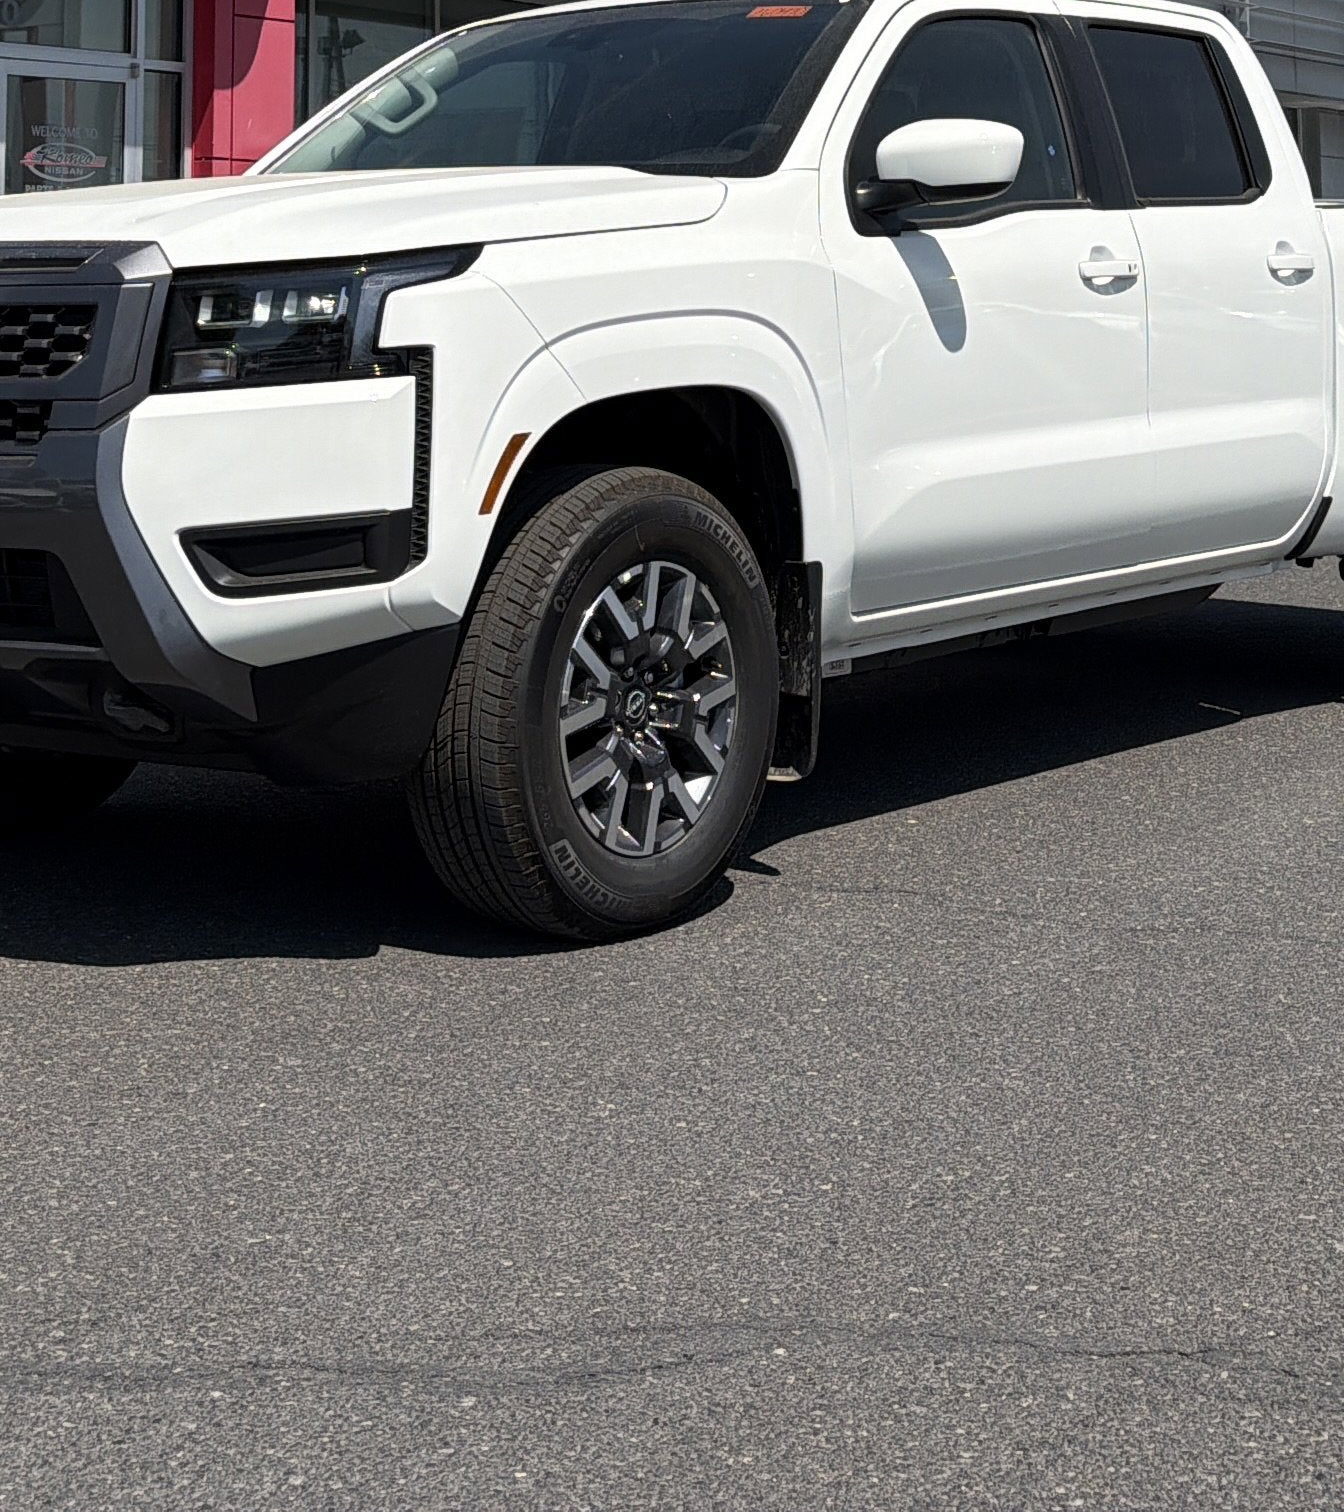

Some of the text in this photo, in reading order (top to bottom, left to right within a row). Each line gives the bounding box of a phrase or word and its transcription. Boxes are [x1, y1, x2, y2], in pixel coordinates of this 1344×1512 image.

[31, 124, 81, 138] WELCOME
[35, 144, 94, 165] Romeo
[44, 165, 84, 176] NISSAN
[695, 510, 758, 583] MICHELIN
